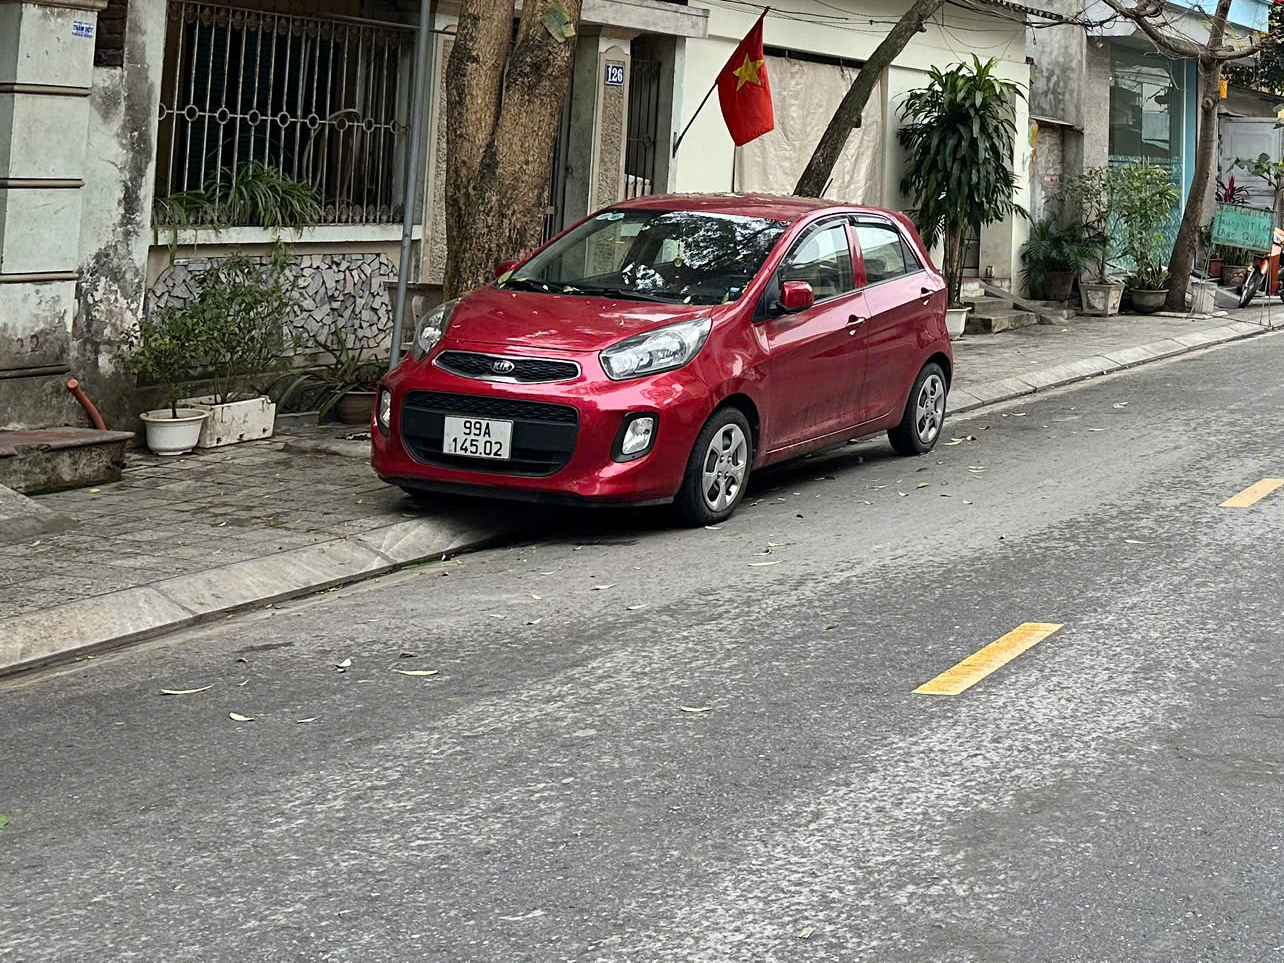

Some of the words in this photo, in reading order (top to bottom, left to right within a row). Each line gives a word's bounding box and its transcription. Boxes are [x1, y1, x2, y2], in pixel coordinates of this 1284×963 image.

[607, 65, 623, 82] 126
[493, 361, 511, 371] KIA
[463, 420, 491, 438] 99A
[452, 437, 503, 457] 145.02
